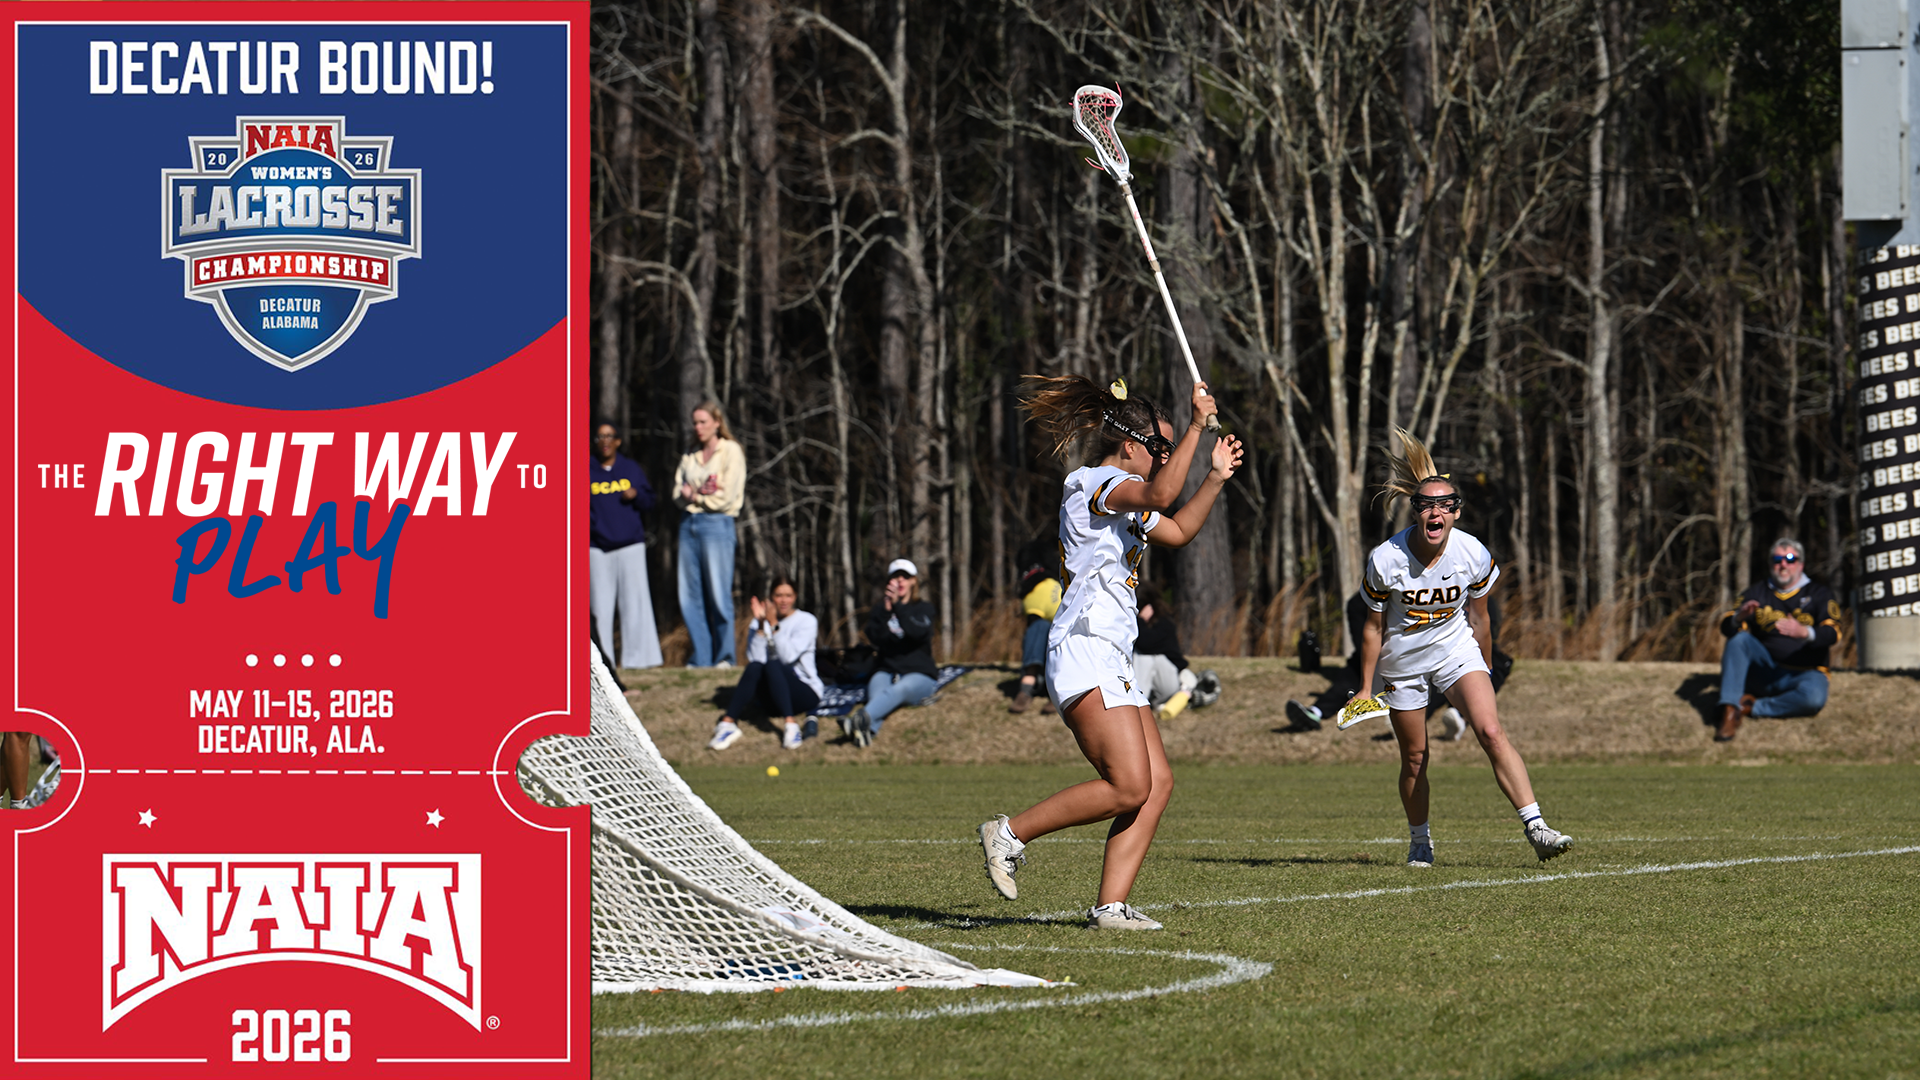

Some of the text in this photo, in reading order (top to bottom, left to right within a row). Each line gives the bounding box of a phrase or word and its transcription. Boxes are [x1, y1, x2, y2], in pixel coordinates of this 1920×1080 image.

[1861, 351, 1909, 379] BEES
[1866, 405, 1918, 433] BEES
[590, 477, 632, 496] SCAD
[1861, 491, 1908, 519] BEES
[1865, 546, 1917, 574] BEES
[1400, 584, 1462, 606] SCAD
